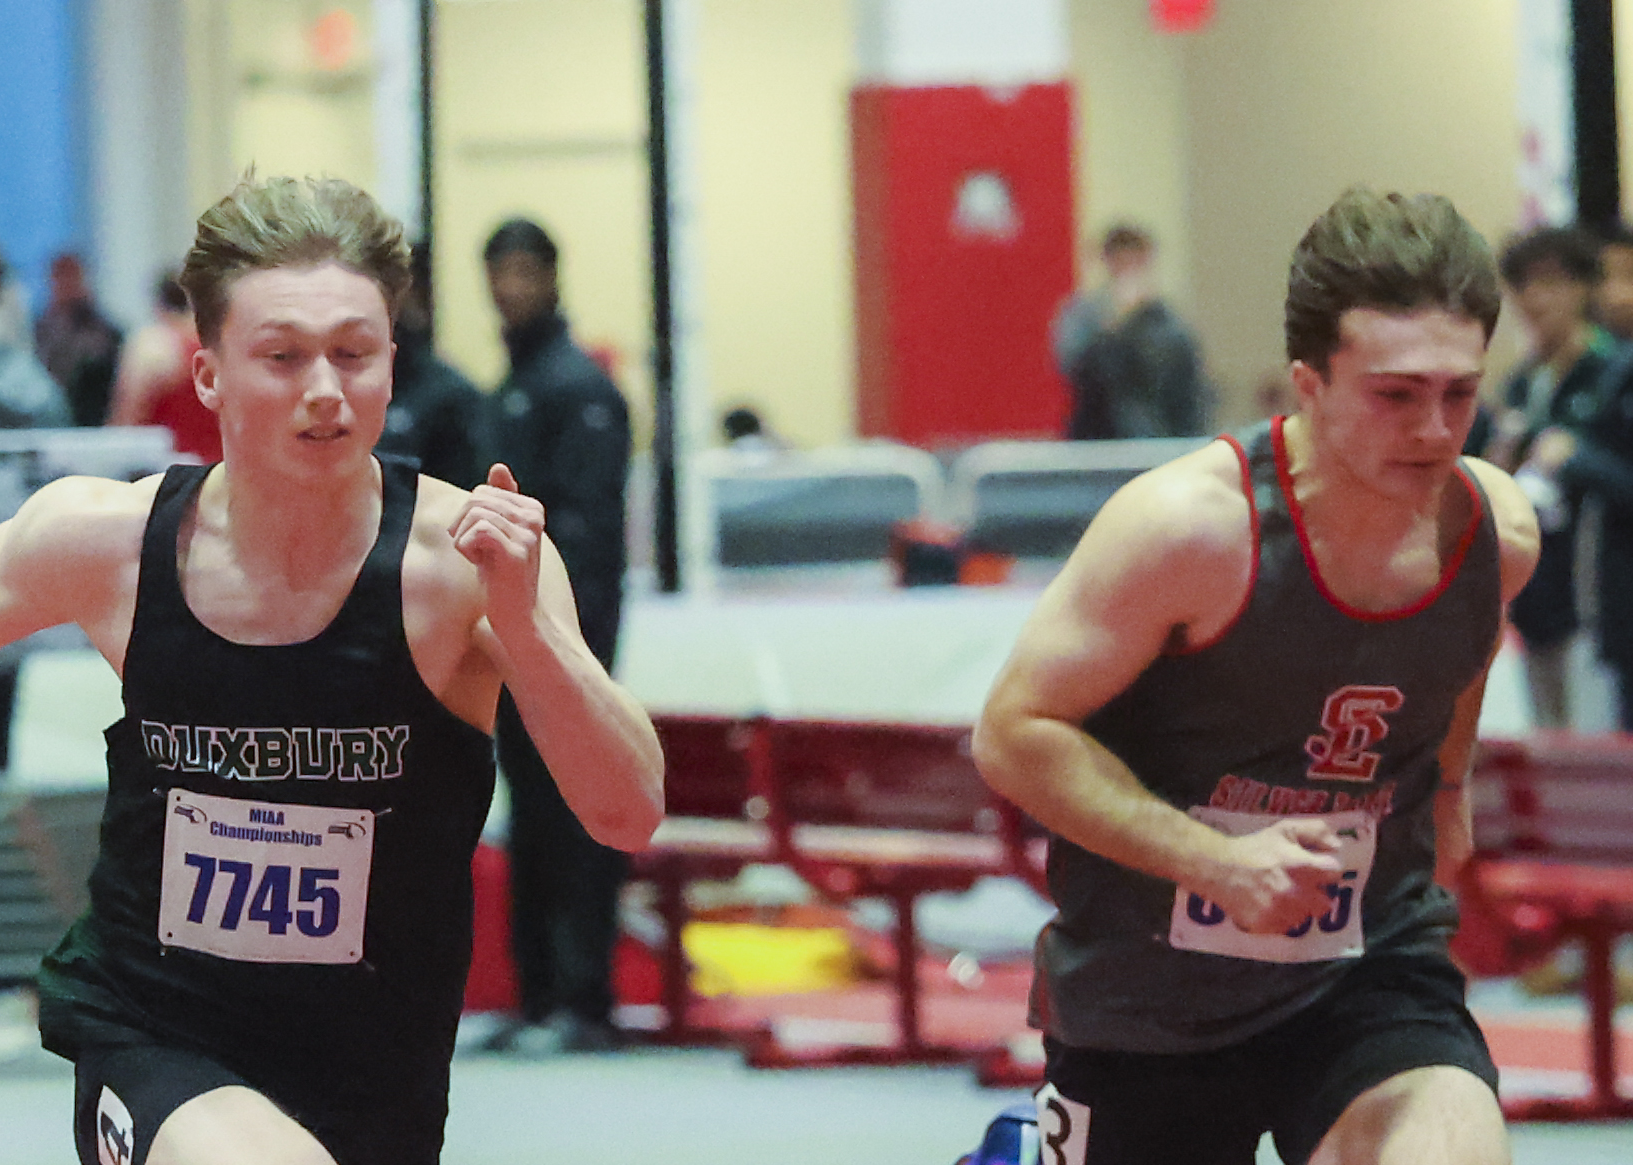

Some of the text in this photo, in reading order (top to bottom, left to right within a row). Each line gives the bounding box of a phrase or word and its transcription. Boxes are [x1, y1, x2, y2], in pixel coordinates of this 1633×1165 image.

[141, 719, 410, 782] DUXBURY
[210, 821, 323, 847] Championships
[249, 808, 285, 826] MIAA
[184, 852, 341, 938] 7745
